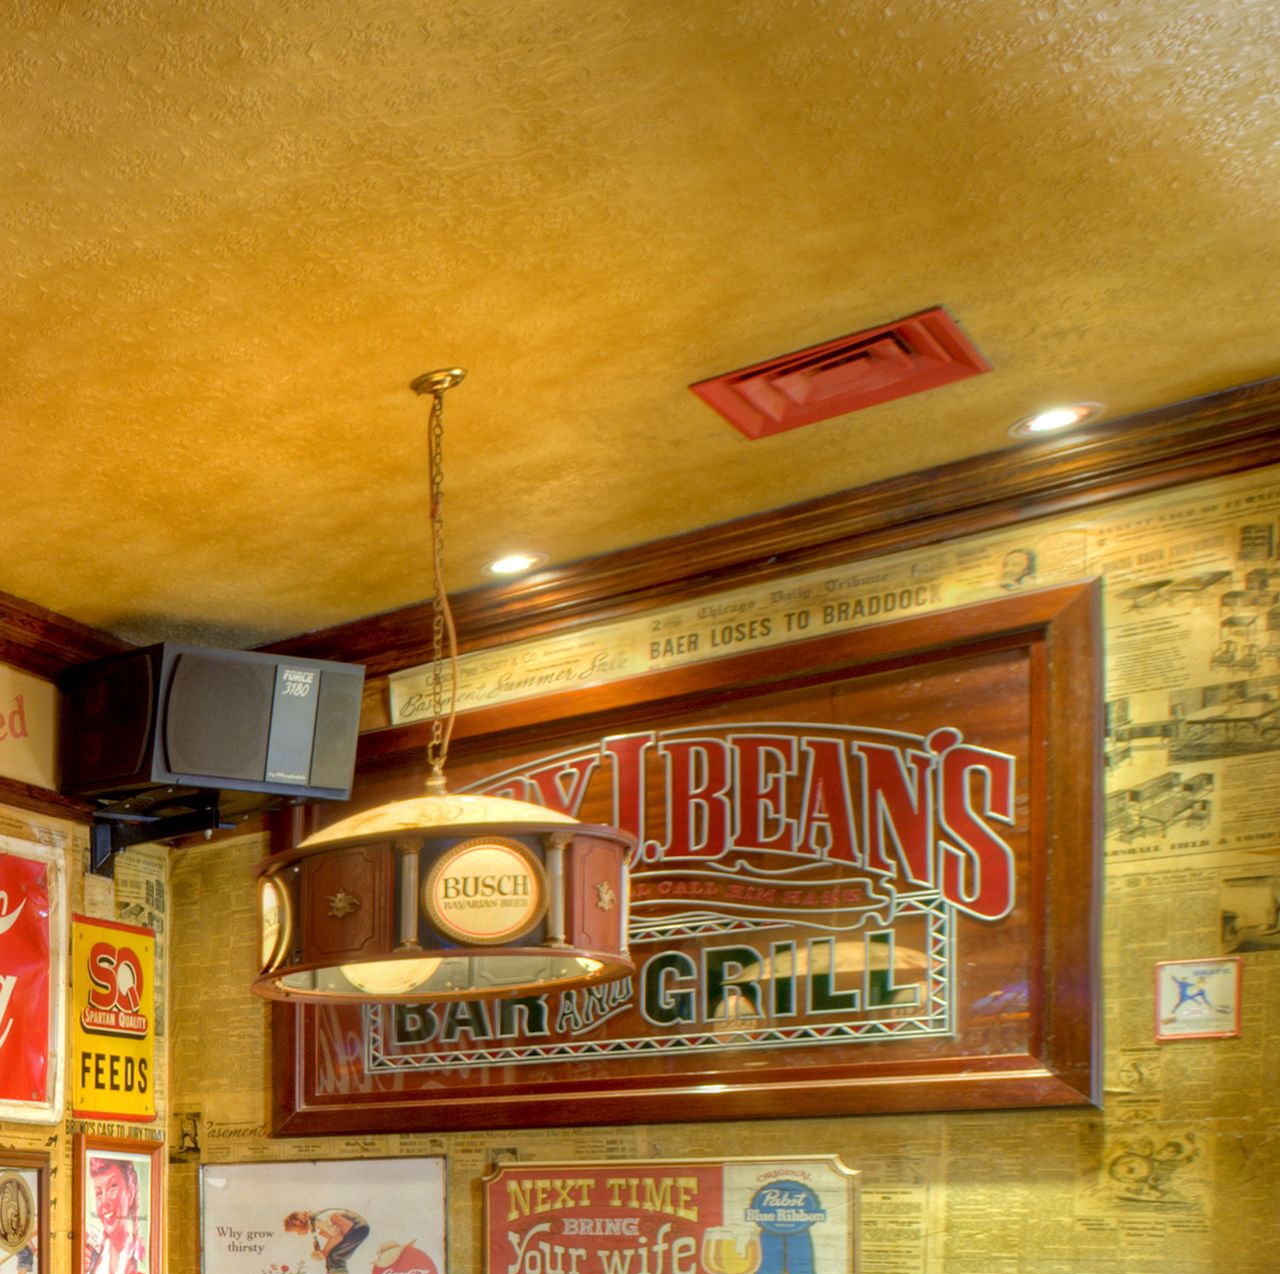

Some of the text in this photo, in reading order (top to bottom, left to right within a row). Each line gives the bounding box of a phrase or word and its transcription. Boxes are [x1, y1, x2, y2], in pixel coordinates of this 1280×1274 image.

[649, 633, 700, 661] BAER
[710, 617, 772, 648] LOSES
[784, 610, 810, 633] TO
[489, 667, 577, 699] Summer
[658, 726, 1016, 922] BEAN'S
[442, 875, 529, 899] BUSCH
[88, 941, 143, 1013] SQ
[641, 929, 922, 1028] GRILL
[83, 1008, 147, 1030] SPARTAN QUALITY
[80, 1051, 148, 1094] FEEDS
[97, 1120, 115, 1136] CASE
[506, 1177, 700, 1223] NEXT TIME
[760, 1188, 807, 1208] Pabst
[562, 1218, 640, 1236] BRING
[745, 1208, 827, 1222] Blue Ribbon
[215, 1226, 275, 1242] Why grow
[227, 1241, 265, 1255] thirsty
